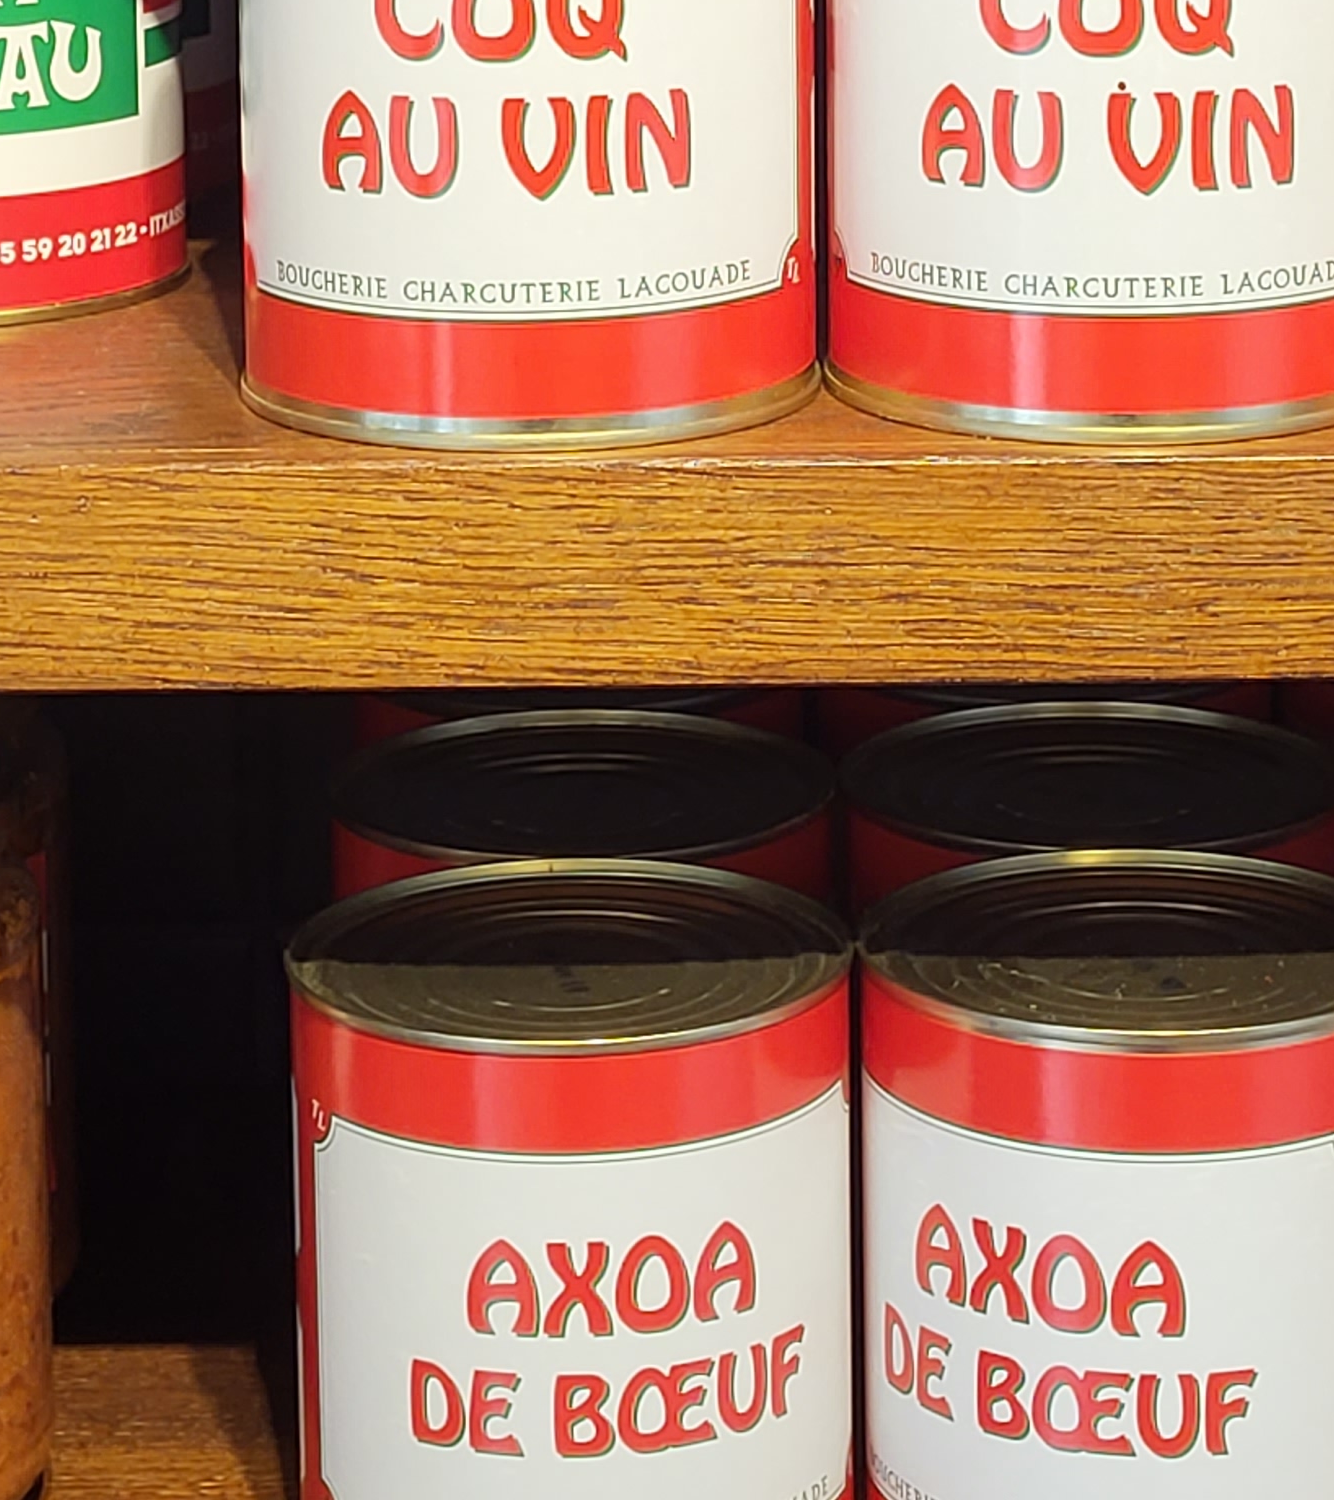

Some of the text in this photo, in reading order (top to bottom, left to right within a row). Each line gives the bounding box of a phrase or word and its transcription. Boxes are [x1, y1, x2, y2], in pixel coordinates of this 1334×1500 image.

[320, 87, 693, 202] AU VIN
[920, 82, 1296, 198] AU VIN
[21, 237, 54, 263] 59
[58, 231, 87, 259] 20
[276, 259, 752, 305] BOUCHERIE CHARCUTERIE LACOUADE
[870, 251, 989, 294] BOUCHERIE
[1004, 272, 1204, 299] CHARCUTERIE
[466, 1219, 757, 1338] AXOA
[915, 1202, 1187, 1338] AXOA
[409, 1323, 805, 1459] DE BŒUF
[884, 1301, 1259, 1460] DE BŒUF
